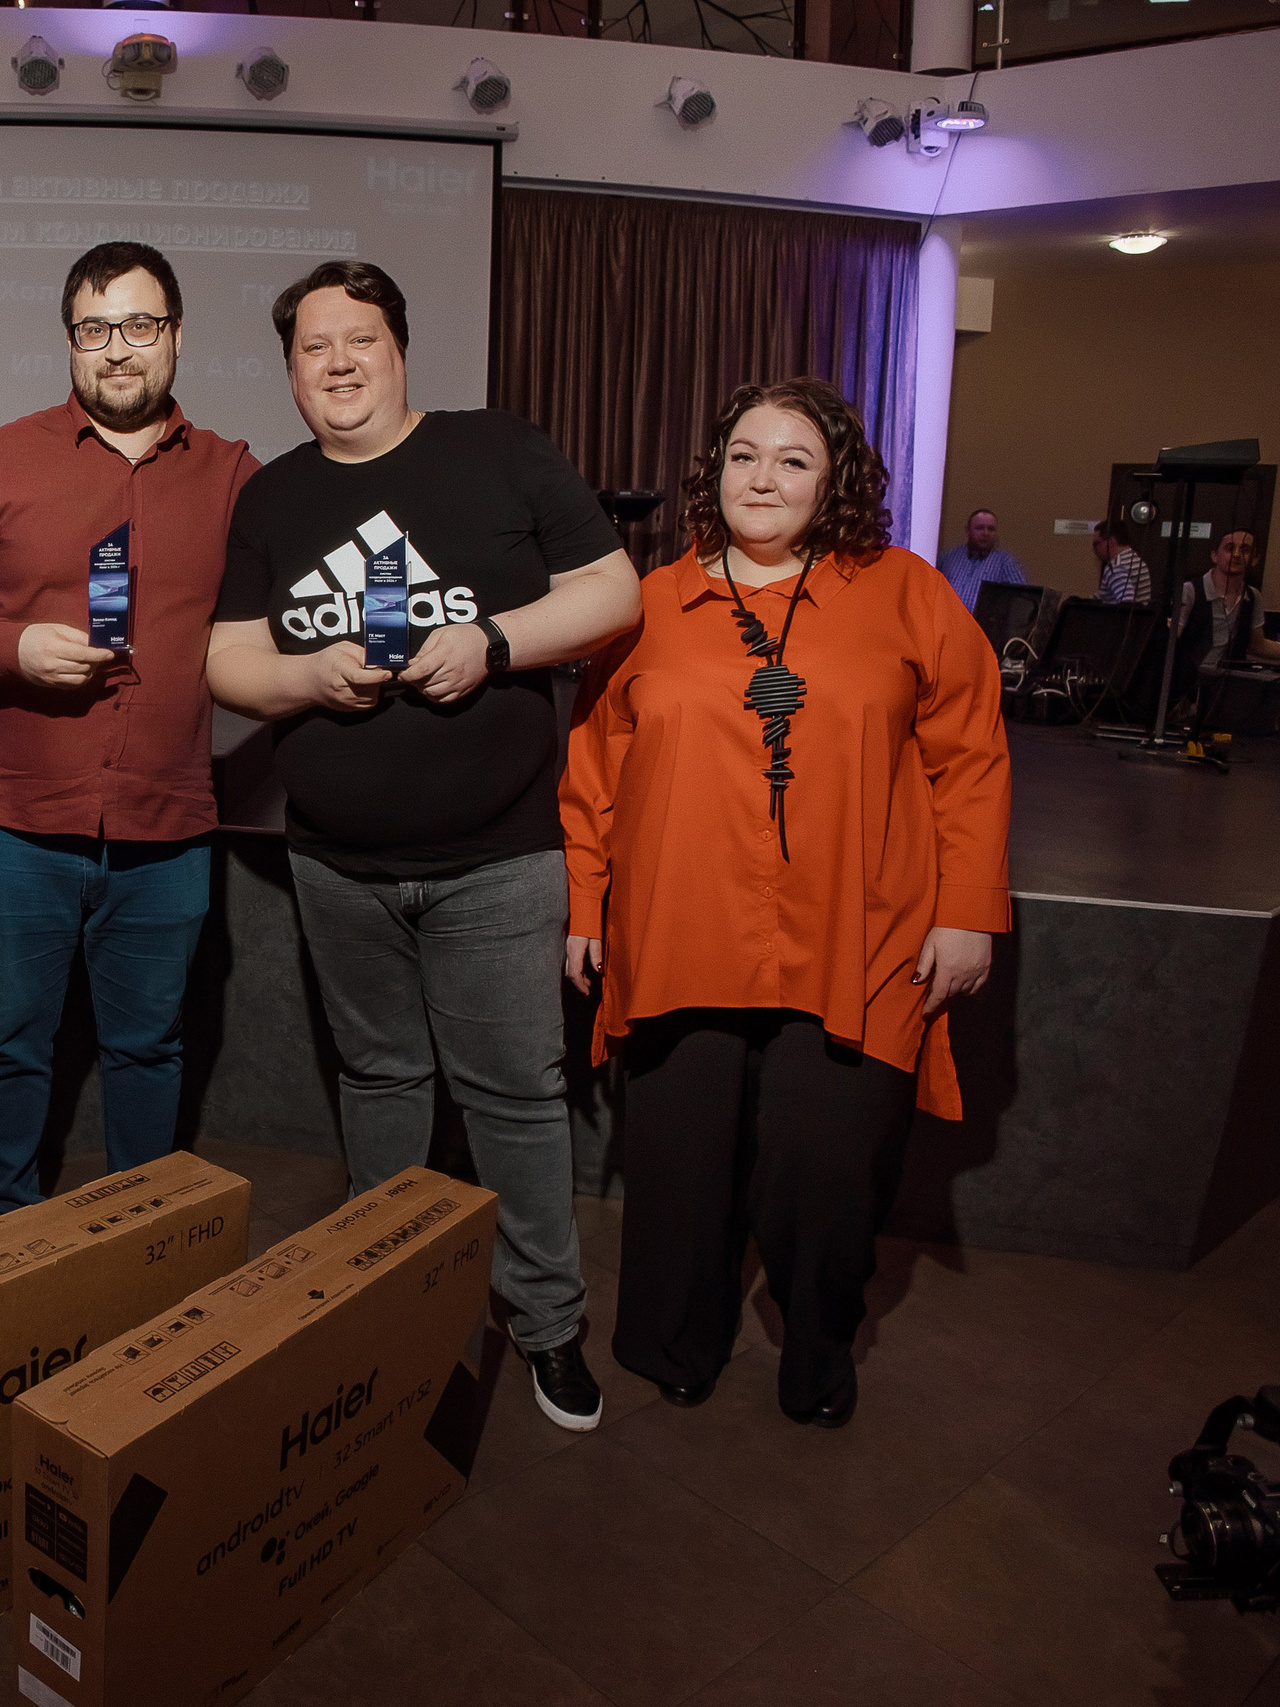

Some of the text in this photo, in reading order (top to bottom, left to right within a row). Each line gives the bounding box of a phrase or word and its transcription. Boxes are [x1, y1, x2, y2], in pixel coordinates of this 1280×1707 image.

[11, 175, 163, 200] активные
[171, 179, 310, 205] продажи
[366, 155, 476, 195] Haier
[281, 586, 478, 640] adias
[326, 1178, 418, 1235] Haier androidtv
[188, 1216, 225, 1248] FHD
[452, 1239, 480, 1273] FHD
[278, 1367, 379, 1473] Haier
[39, 1454, 75, 1487] Haier
[196, 1478, 306, 1577] androidtv
[354, 1410, 395, 1453] Smart
[397, 1391, 416, 1418] TV
[335, 1463, 381, 1509] Google
[278, 1560, 308, 1599] Full
[309, 1539, 335, 1572] HD
[336, 1516, 359, 1547] TV
